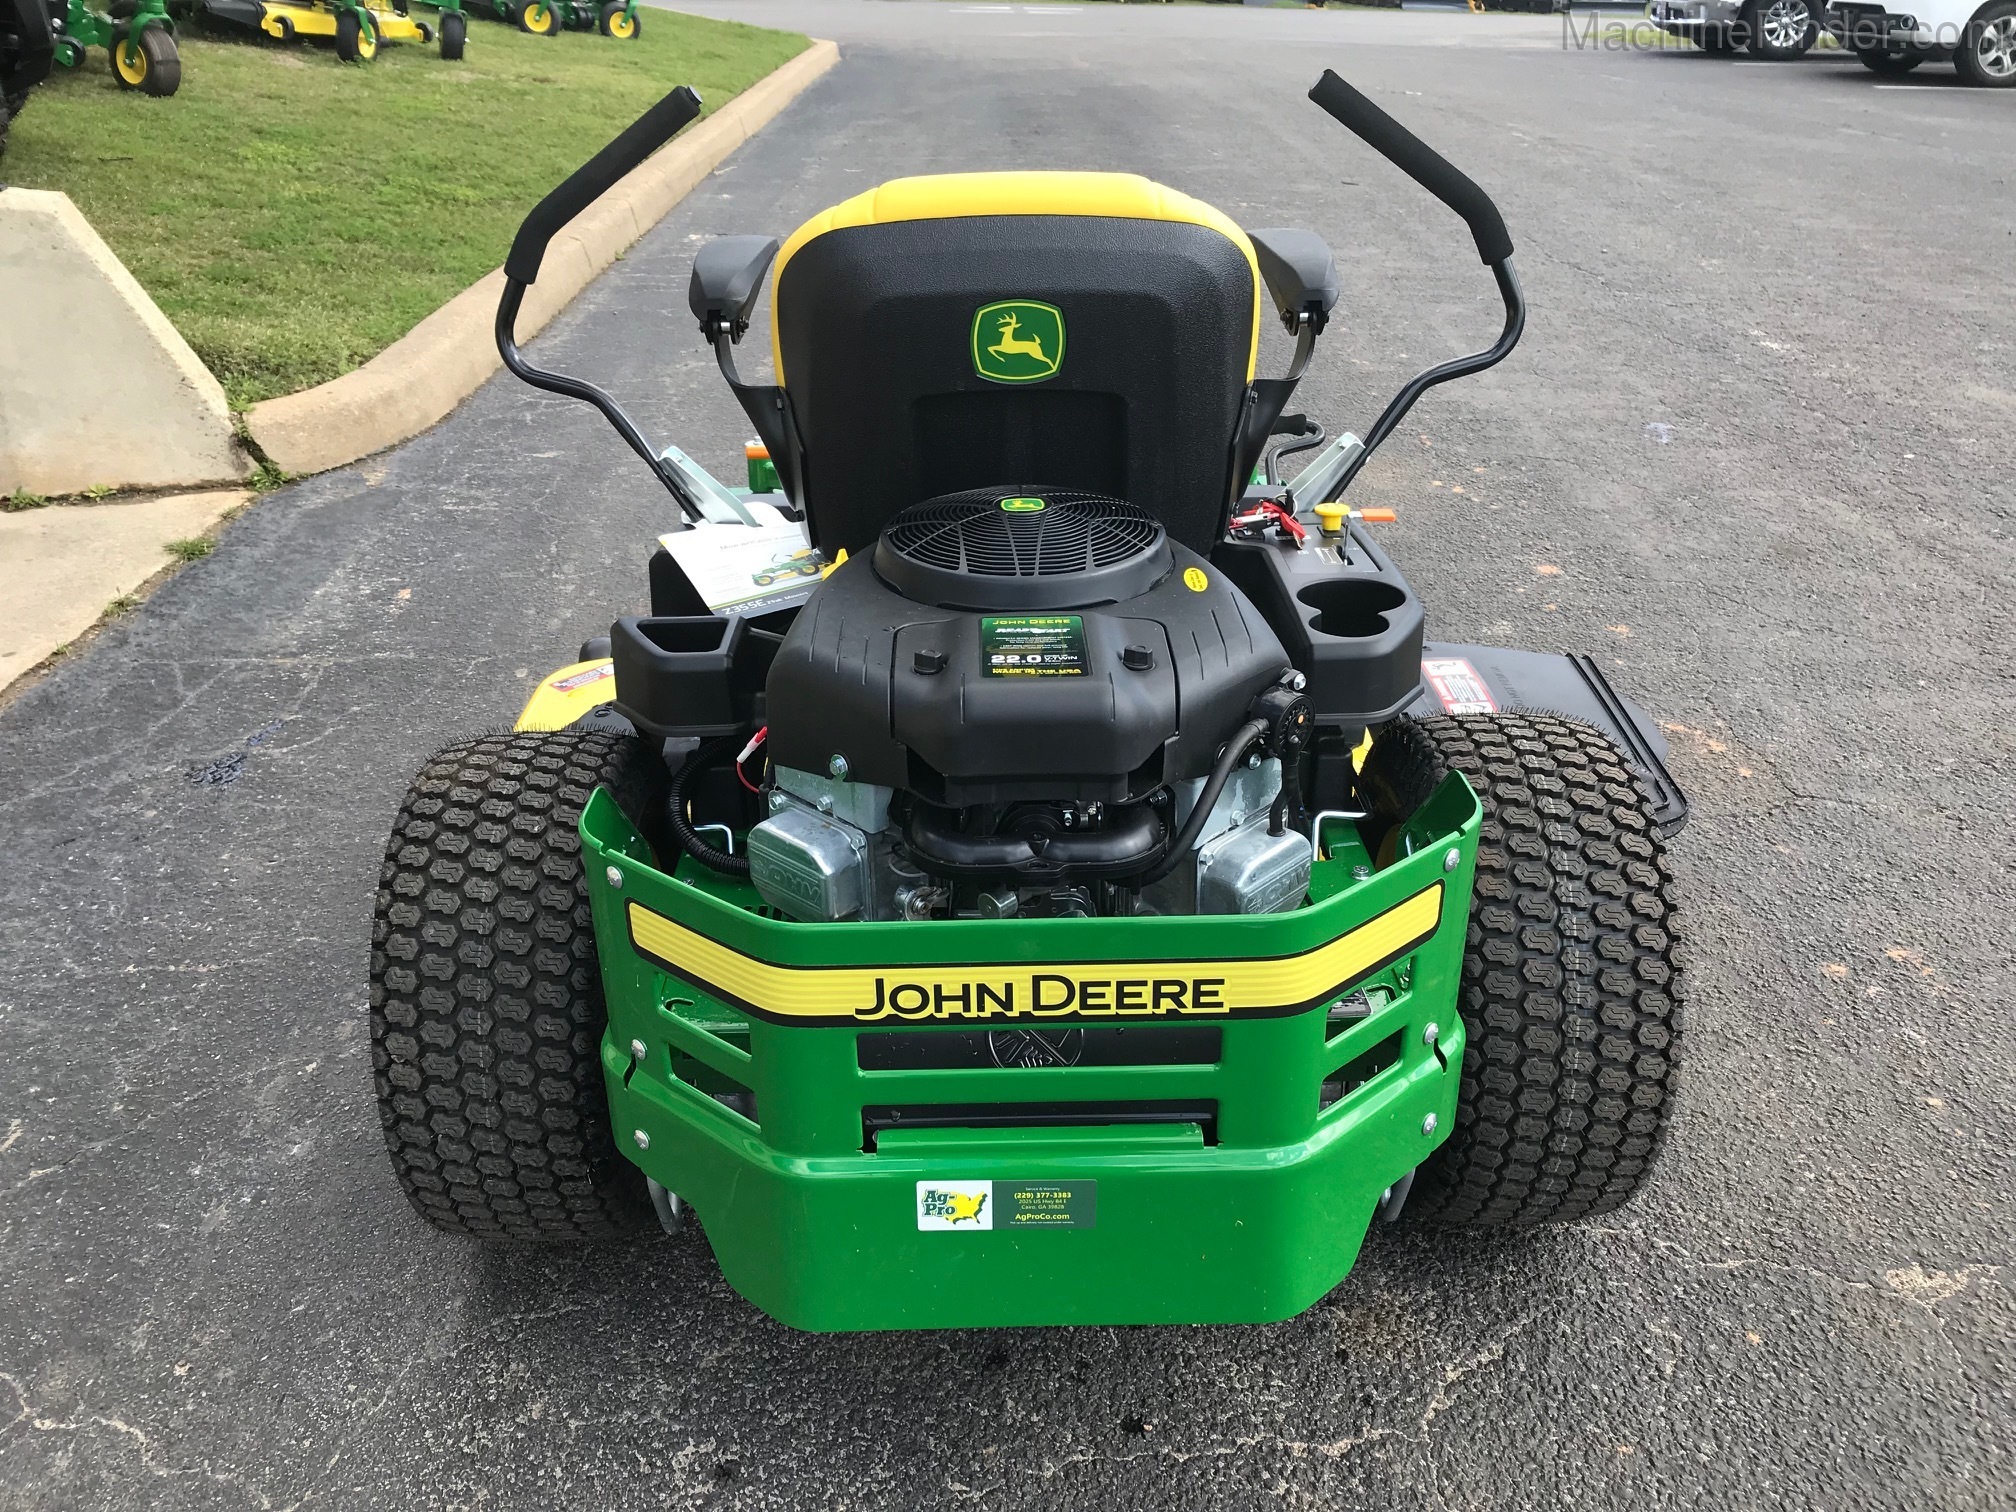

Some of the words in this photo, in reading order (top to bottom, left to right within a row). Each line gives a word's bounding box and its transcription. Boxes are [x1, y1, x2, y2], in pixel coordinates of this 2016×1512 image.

[721, 598, 767, 615] Z355E
[991, 654, 1042, 663] 22.0
[854, 977, 1014, 1016] JOHN
[1031, 974, 1226, 1013] DEERE
[924, 1190, 956, 1206] Ag-
[1013, 1192, 1034, 1200] (229)
[924, 1203, 956, 1216] Pro
[1015, 1213, 1070, 1222] AgProCo.com
